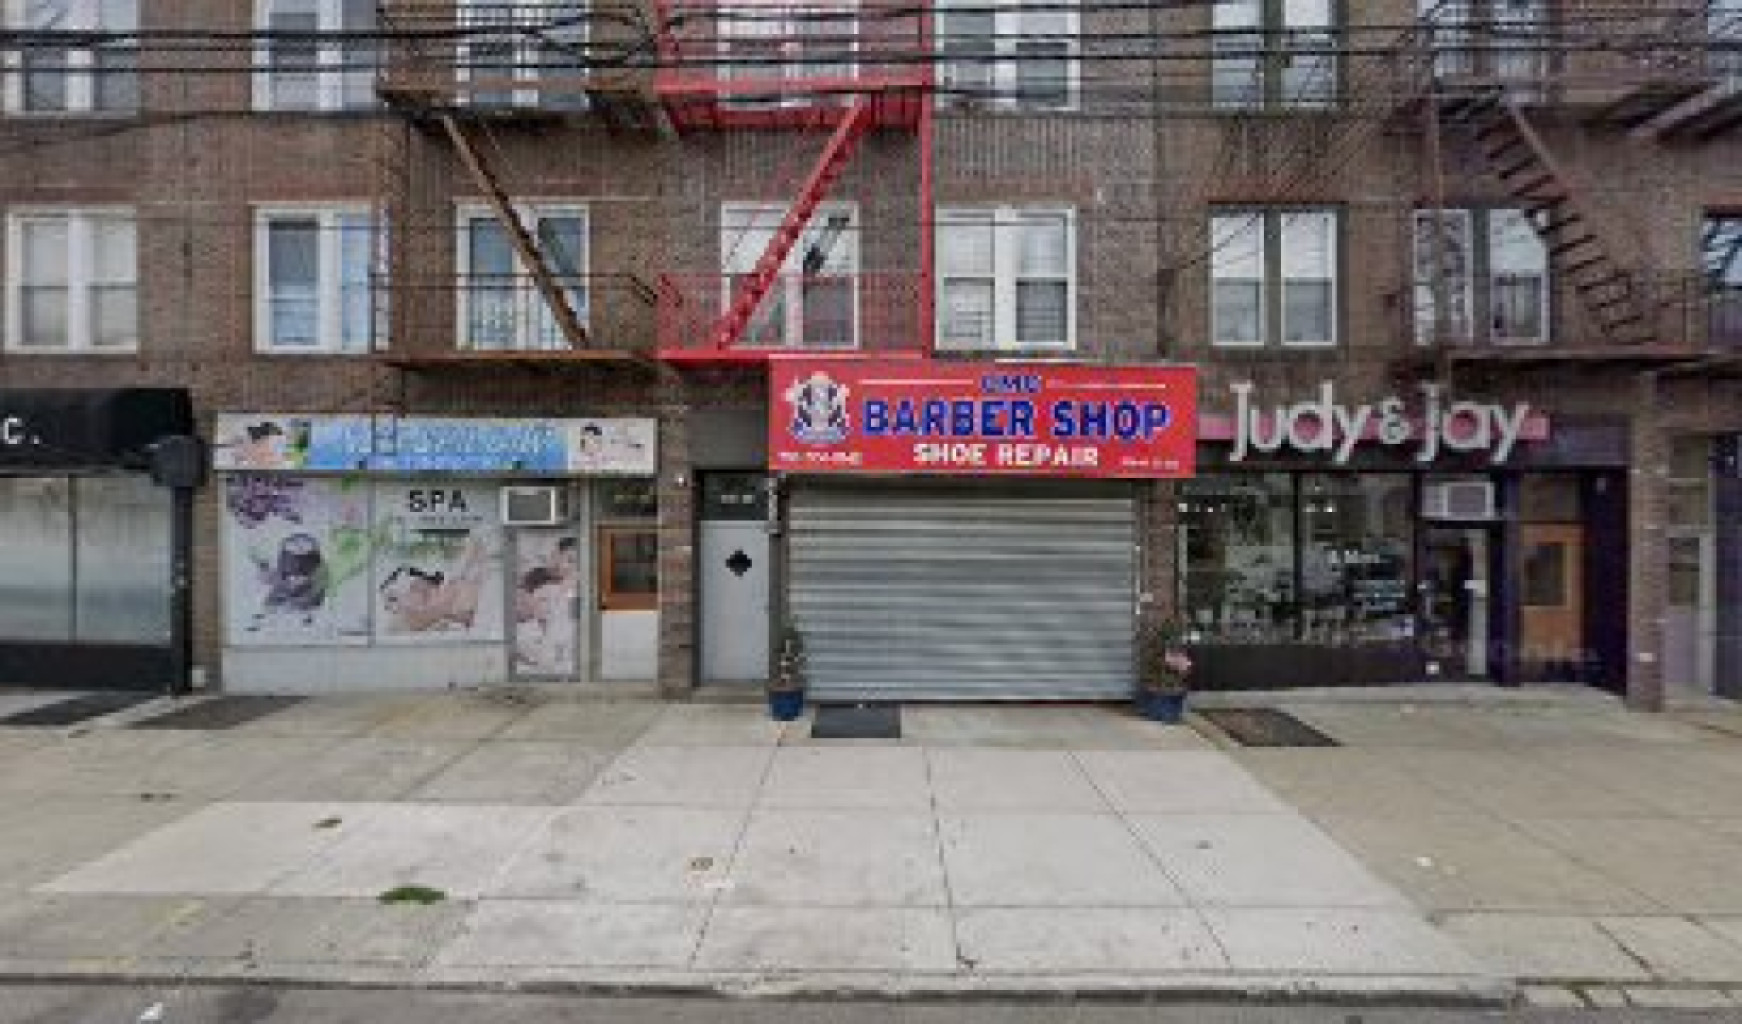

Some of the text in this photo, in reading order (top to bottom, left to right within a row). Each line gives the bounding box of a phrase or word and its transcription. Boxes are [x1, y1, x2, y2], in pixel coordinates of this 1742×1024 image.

[862, 399, 1171, 442] BARBER SHOP
[1229, 380, 1531, 465] Judy & Jay
[913, 443, 988, 467] SHOE
[998, 444, 1099, 467] REPAIR
[408, 489, 468, 513] SPA
